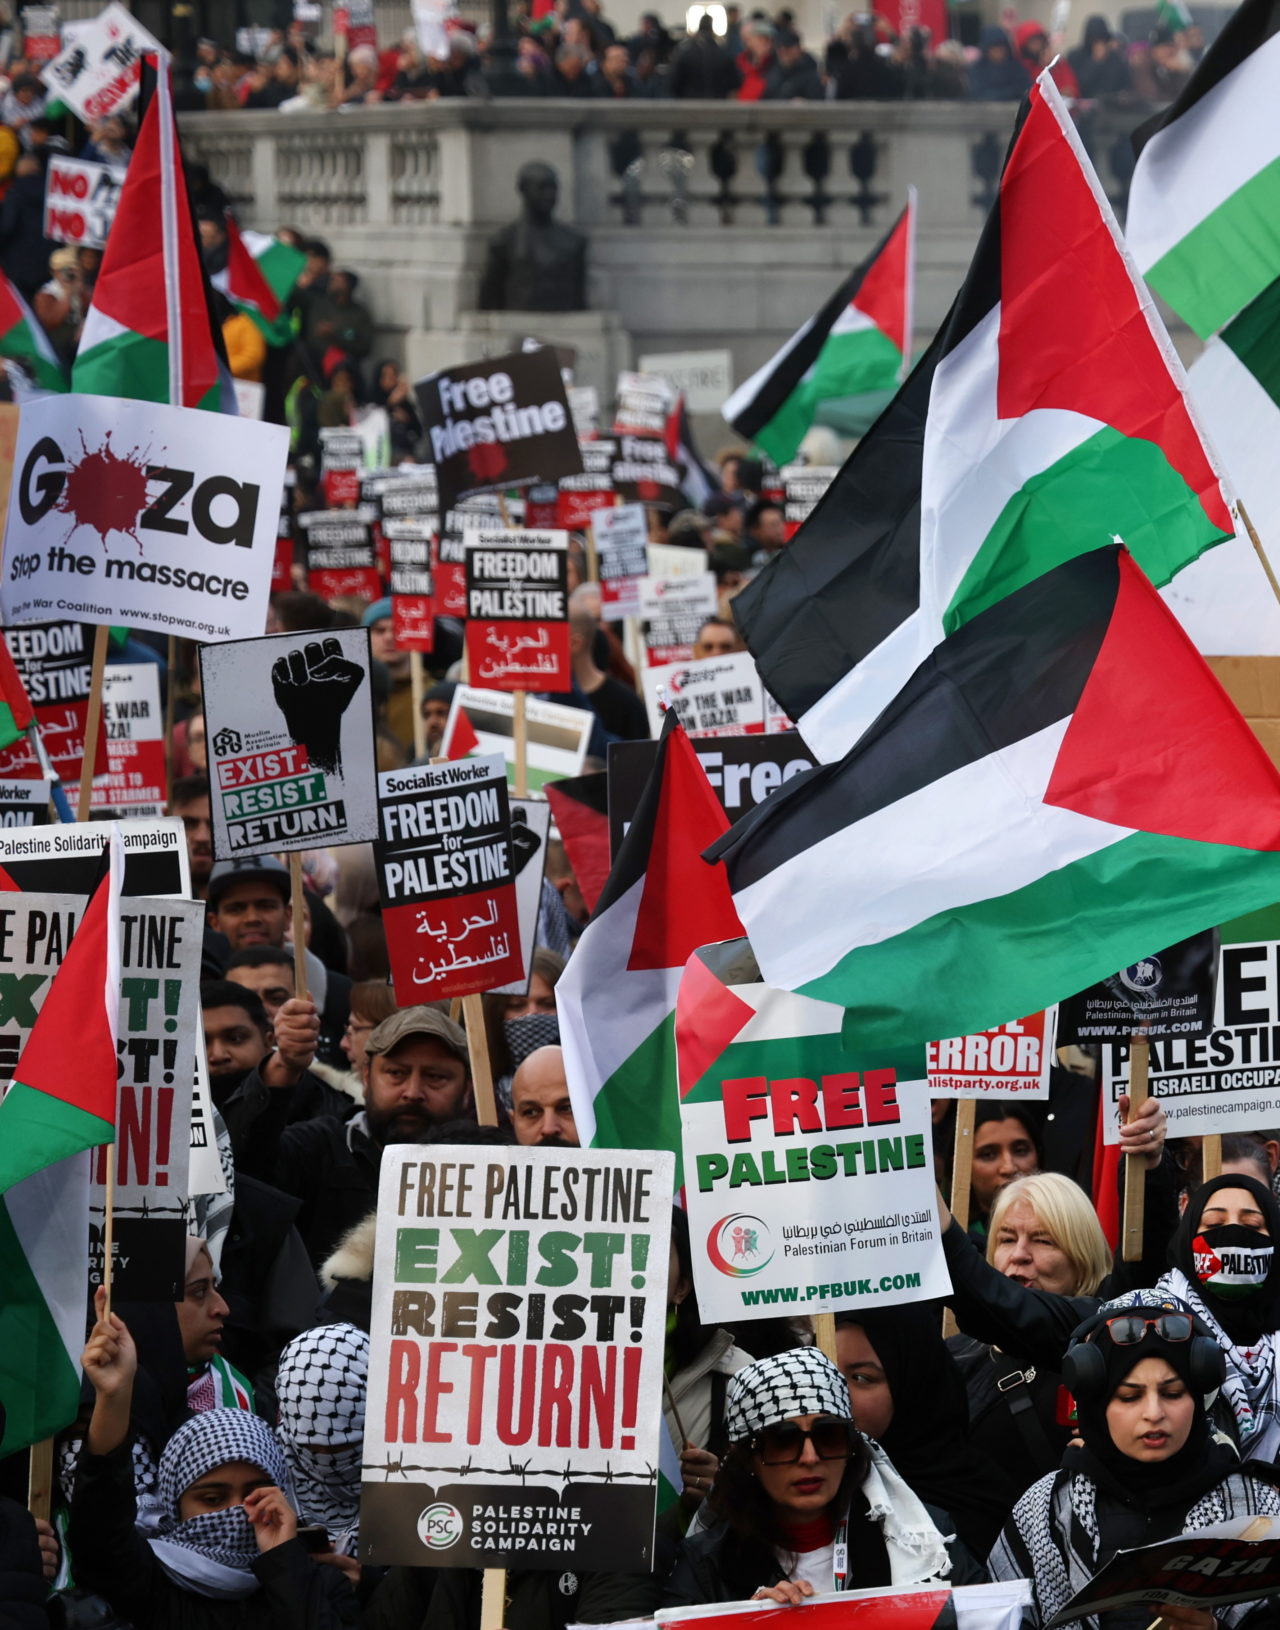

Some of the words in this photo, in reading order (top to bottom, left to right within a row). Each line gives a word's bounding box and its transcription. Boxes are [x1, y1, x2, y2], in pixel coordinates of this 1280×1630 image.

[438, 371, 514, 414] Free
[10, 554, 40, 581] Stop
[48, 547, 96, 575] the
[105, 557, 250, 601] massacre
[473, 552, 559, 580] FREEDOM
[33, 598, 53, 609] War
[57, 599, 113, 615] Coalition
[119, 606, 231, 636] www.stopwar.org.uk
[469, 590, 564, 618] PALESTINE
[4, 623, 83, 659] EEDOM
[24, 658, 42, 673] for
[116, 700, 150, 719] WAR
[721, 687, 753, 706] WAR
[218, 749, 306, 787] EXIST.
[223, 777, 325, 817] RESIST.
[229, 804, 346, 849] RETURN.
[382, 788, 499, 842] FREEDOM
[122, 830, 178, 848] ampaign
[441, 834, 463, 851] for
[384, 841, 510, 898] PALESTINE
[415, 899, 498, 943] الحرية
[412, 931, 510, 984] لفلسطين
[1086, 1010, 1131, 1020] Palestinian
[1133, 1010, 1159, 1020] Forum
[1161, 1009, 1168, 1018] in
[1170, 1007, 1197, 1017] Britain
[928, 1035, 1041, 1072] ERROR
[928, 1076, 1040, 1092] alistparty.org.uk
[1153, 1076, 1216, 1096] ISRAELI
[721, 1068, 900, 1144] FREE
[696, 1133, 926, 1193] PALESTINE
[397, 1162, 475, 1218] FREE
[484, 1163, 653, 1223] PALESTINE
[901, 1209, 931, 1227] المنتدى
[394, 1228, 651, 1290] EXIST!
[784, 1241, 846, 1257] Palestinian
[850, 1237, 886, 1250] Forum
[889, 1233, 898, 1245] in
[901, 1228, 933, 1244] Britain
[741, 1272, 921, 1306] WWW.PFBUK.COM
[391, 1290, 646, 1343] RESIST!
[384, 1340, 642, 1450] RETURN!
[426, 1519, 454, 1535] PSC
[471, 1520, 593, 1537] SOLIDARITY
[472, 1505, 581, 1520] PALESTINE
[470, 1536, 576, 1552] CAMPAIGN
[1162, 1555, 1273, 1577] GAZA
